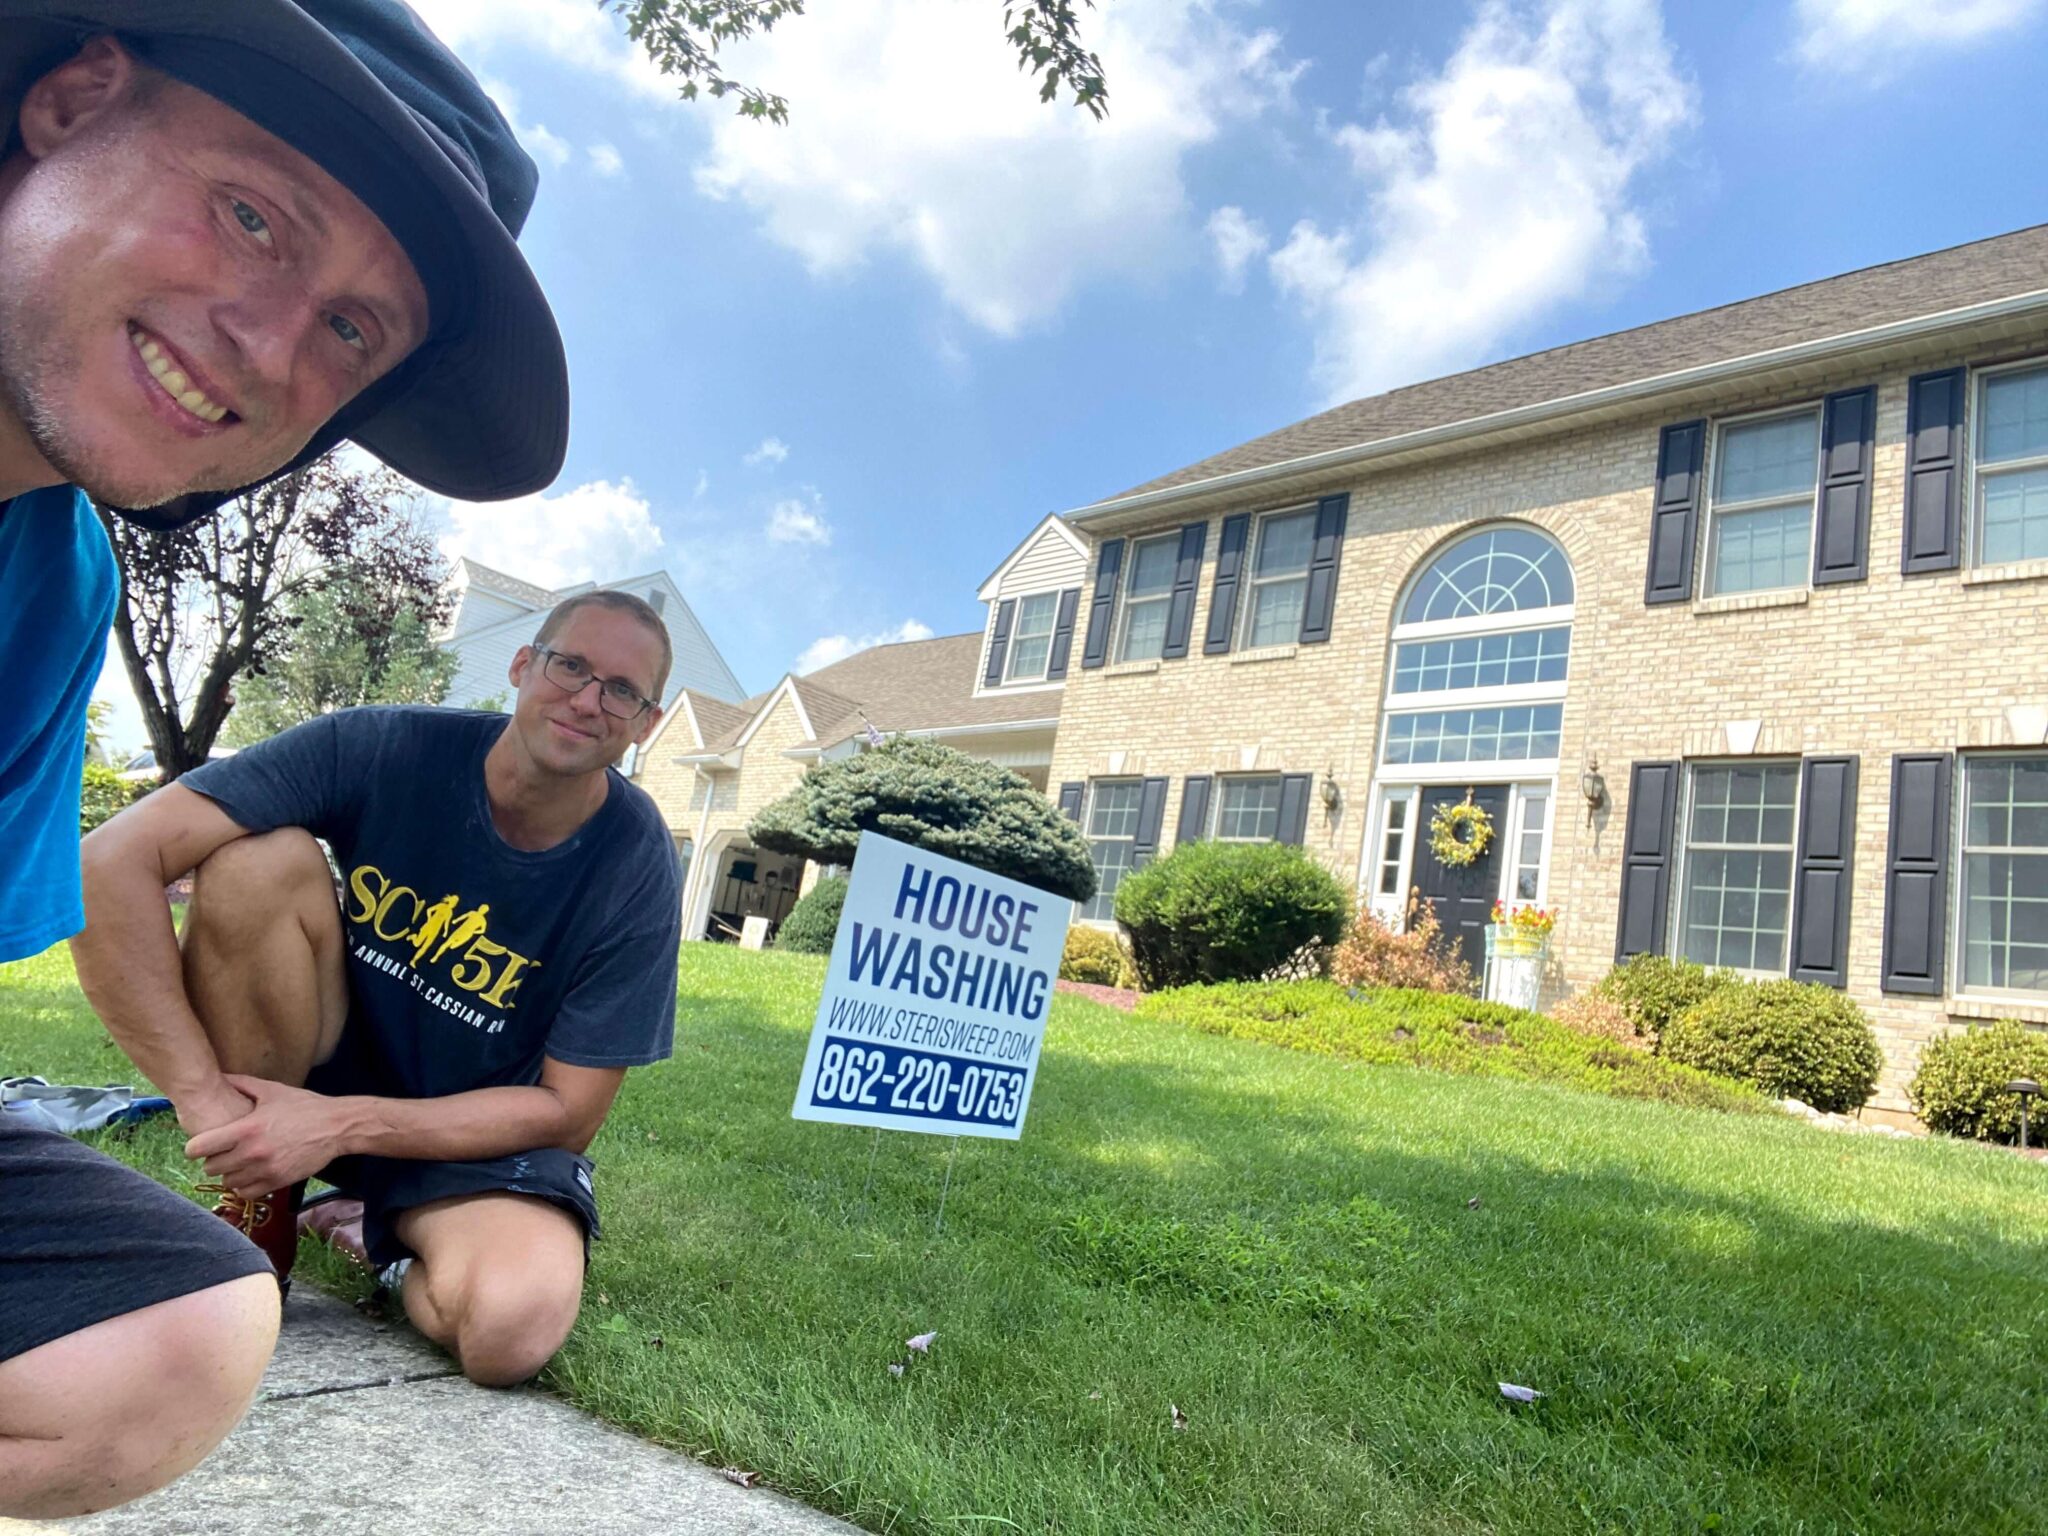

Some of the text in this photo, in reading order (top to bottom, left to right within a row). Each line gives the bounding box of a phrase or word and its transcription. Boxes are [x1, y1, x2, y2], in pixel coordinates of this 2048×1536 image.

[349, 865, 426, 942] SC
[893, 863, 1039, 954] HOUSE
[354, 944, 408, 980] ANNUAL
[848, 921, 1049, 1021] WASHING
[828, 996, 1036, 1063] WWW.STERISWEEP.COM
[816, 1043, 1025, 1121] 862-220-0753
